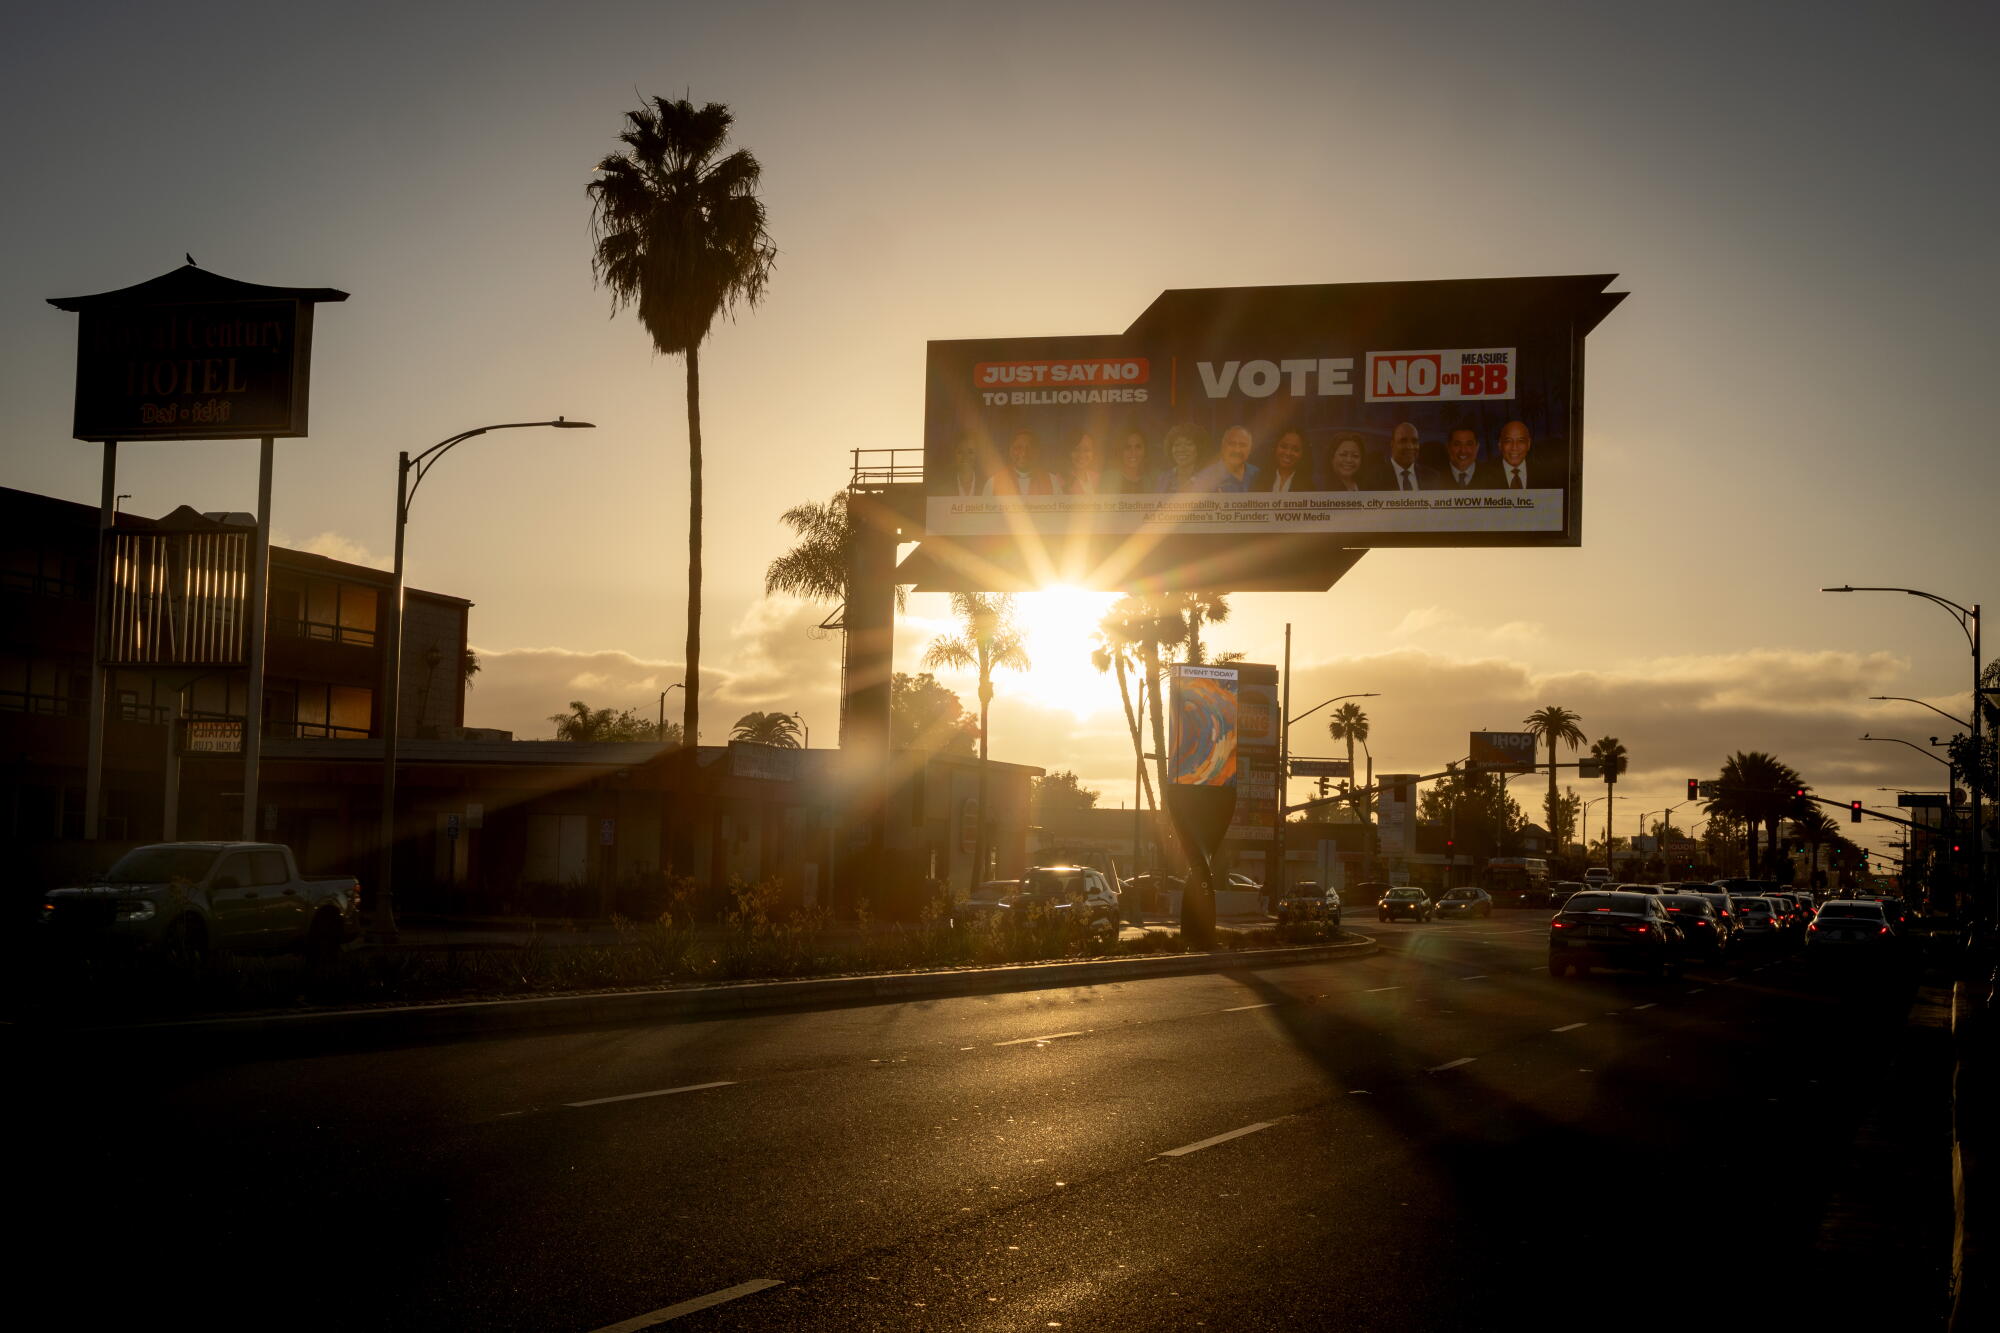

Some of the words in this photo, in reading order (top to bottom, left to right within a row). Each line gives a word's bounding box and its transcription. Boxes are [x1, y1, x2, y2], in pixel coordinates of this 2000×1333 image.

[184, 312, 288, 353] Century
[1461, 352, 1508, 365] MEASURE
[126, 357, 248, 397] HOTEL
[983, 366, 1048, 385] JUST
[1051, 364, 1098, 382] SAY
[1102, 363, 1140, 380] NO
[1197, 357, 1353, 399] VOTE
[1376, 358, 1437, 396] NO
[1442, 371, 1459, 386] on
[1461, 365, 1507, 396] BB
[982, 392, 1007, 405] TO
[1010, 388, 1149, 405] BILLIONAIRES
[951, 503, 962, 512] Ad
[965, 503, 983, 513] paid
[984, 503, 997, 511] for
[1118, 501, 1153, 510] Stadium
[1156, 499, 1222, 511] Accountability,
[1224, 501, 1230, 509] a
[1232, 499, 1270, 509] coalition
[1272, 498, 1282, 508] of
[1283, 498, 1308, 508] small
[1310, 498, 1365, 510] businesses,
[1367, 498, 1385, 510] city
[1386, 498, 1431, 510] residents,
[1434, 498, 1452, 508] and
[1454, 497, 1482, 507] WOW
[1484, 497, 1515, 508] Media,
[1517, 497, 1535, 507] Inc.
[1143, 512, 1156, 521] Ad
[1158, 511, 1213, 521] Committee's
[1216, 511, 1232, 522] Top
[1234, 511, 1269, 521] Funder:
[1275, 511, 1301, 521] WOW
[1303, 511, 1330, 521] Media
[1184, 668, 1208, 676] EVENT
[1209, 670, 1234, 678] TODAY
[1492, 734, 1532, 750] IHOP
